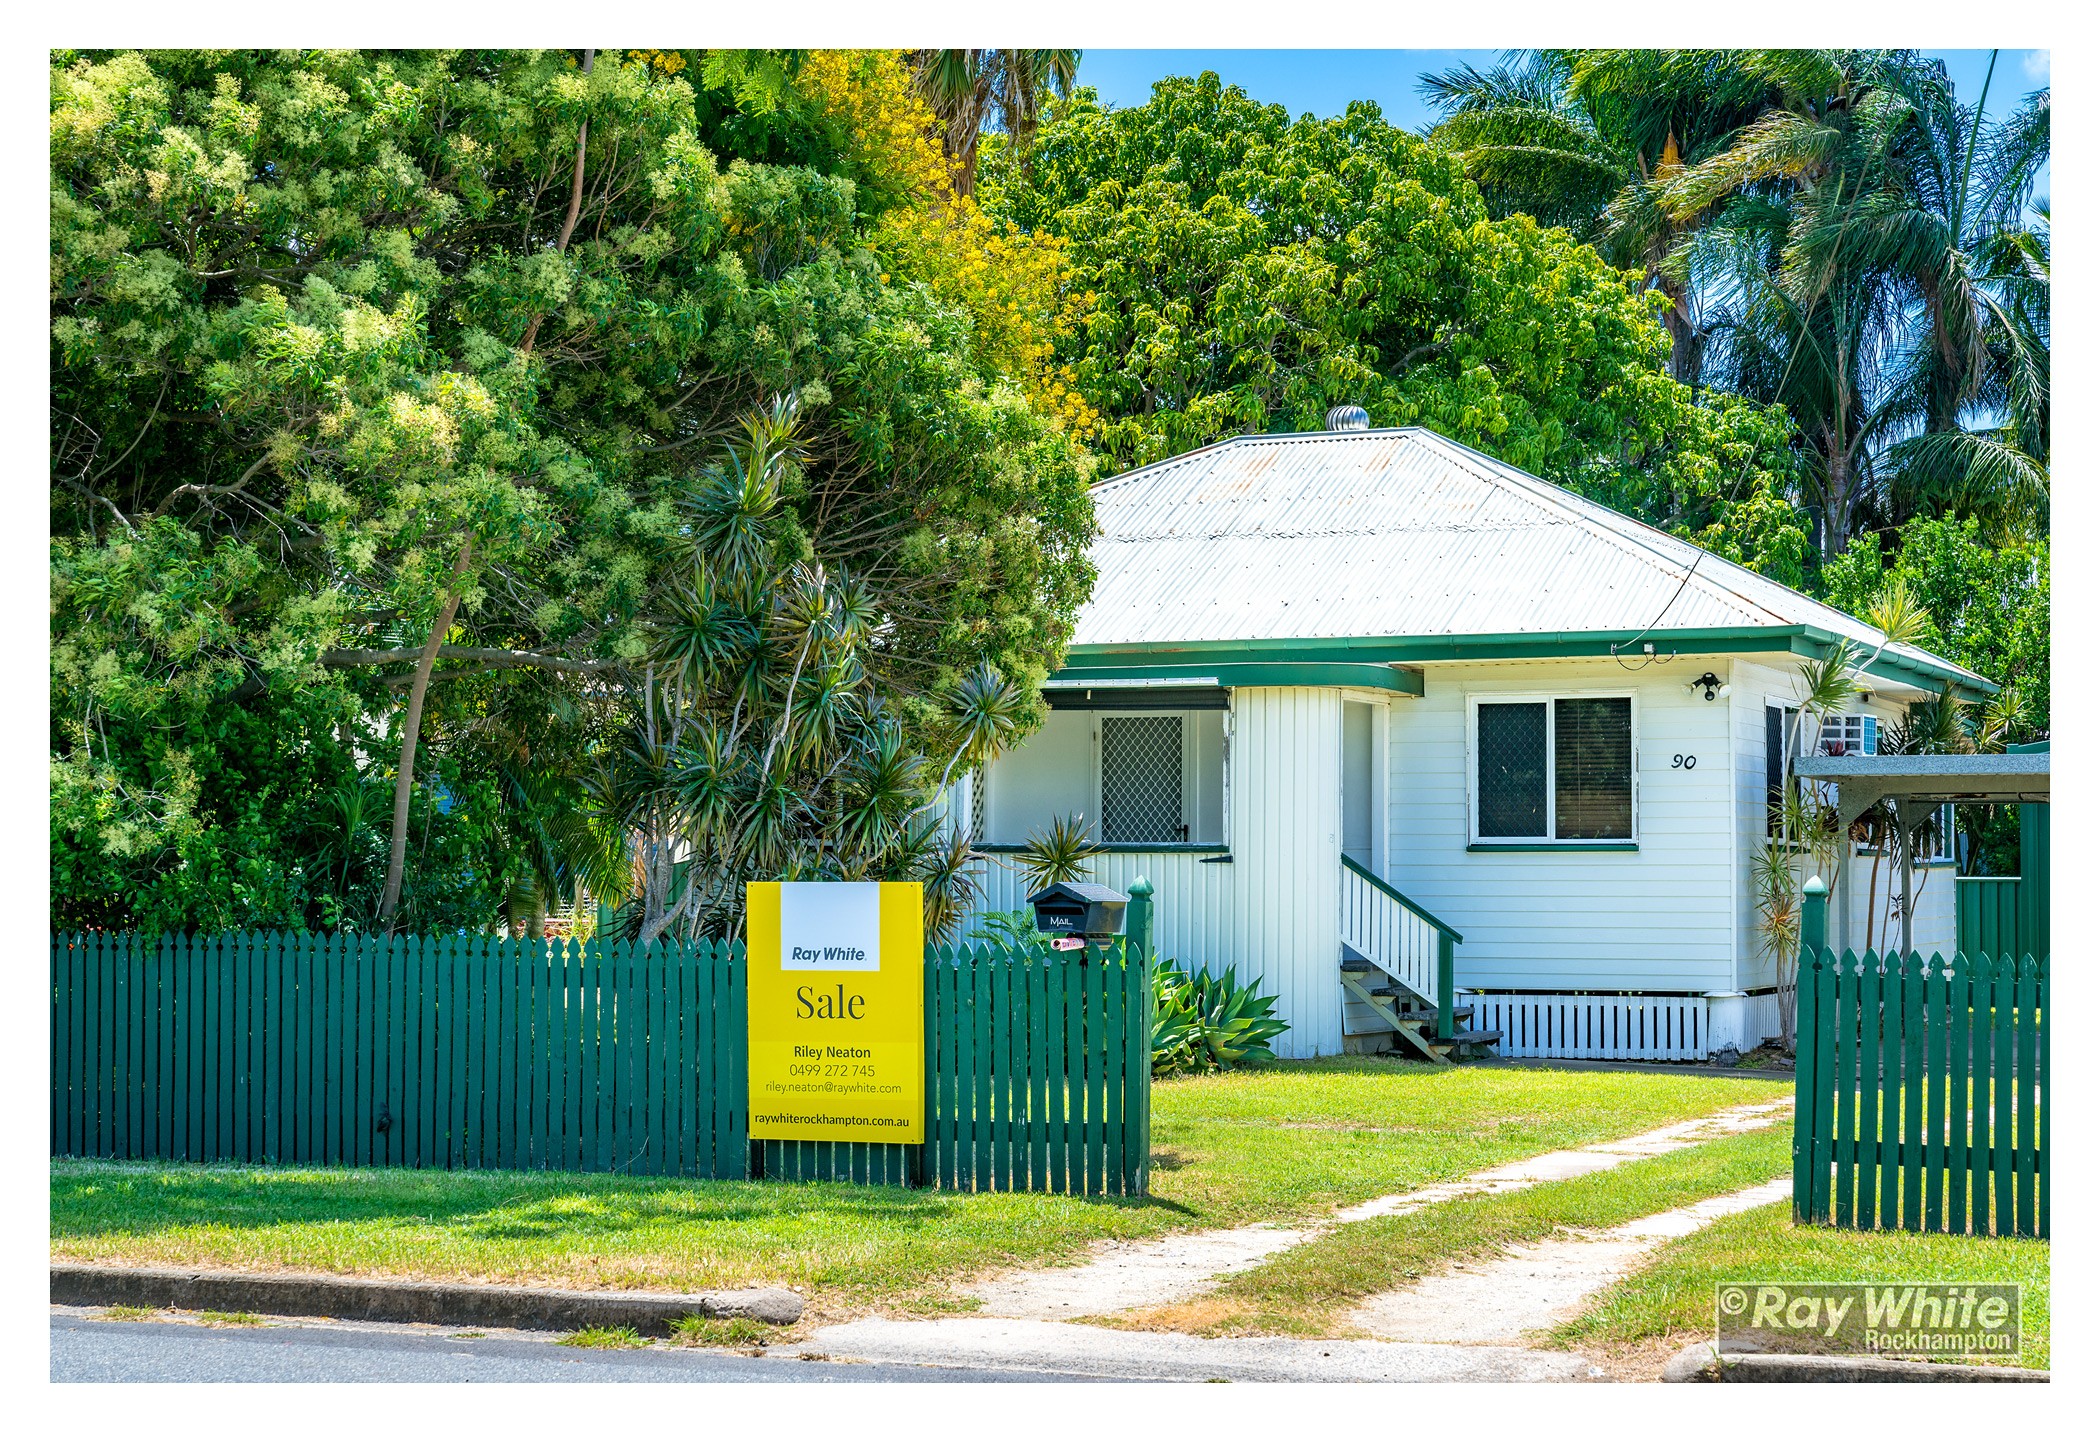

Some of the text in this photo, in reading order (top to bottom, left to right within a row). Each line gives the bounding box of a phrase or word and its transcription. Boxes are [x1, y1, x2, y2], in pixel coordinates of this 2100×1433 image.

[1671, 754, 1697, 770] 90
[1050, 916, 1073, 927] MAIL
[792, 946, 865, 963] Ray White
[796, 984, 865, 1019] Sale
[794, 1045, 871, 1060] Riley Neaton
[789, 1064, 875, 1077] 0499 272 745
[765, 1080, 902, 1095] riley.neaton@raywhite.com
[754, 1112, 909, 1127] raywhiterockhampton.com.au
